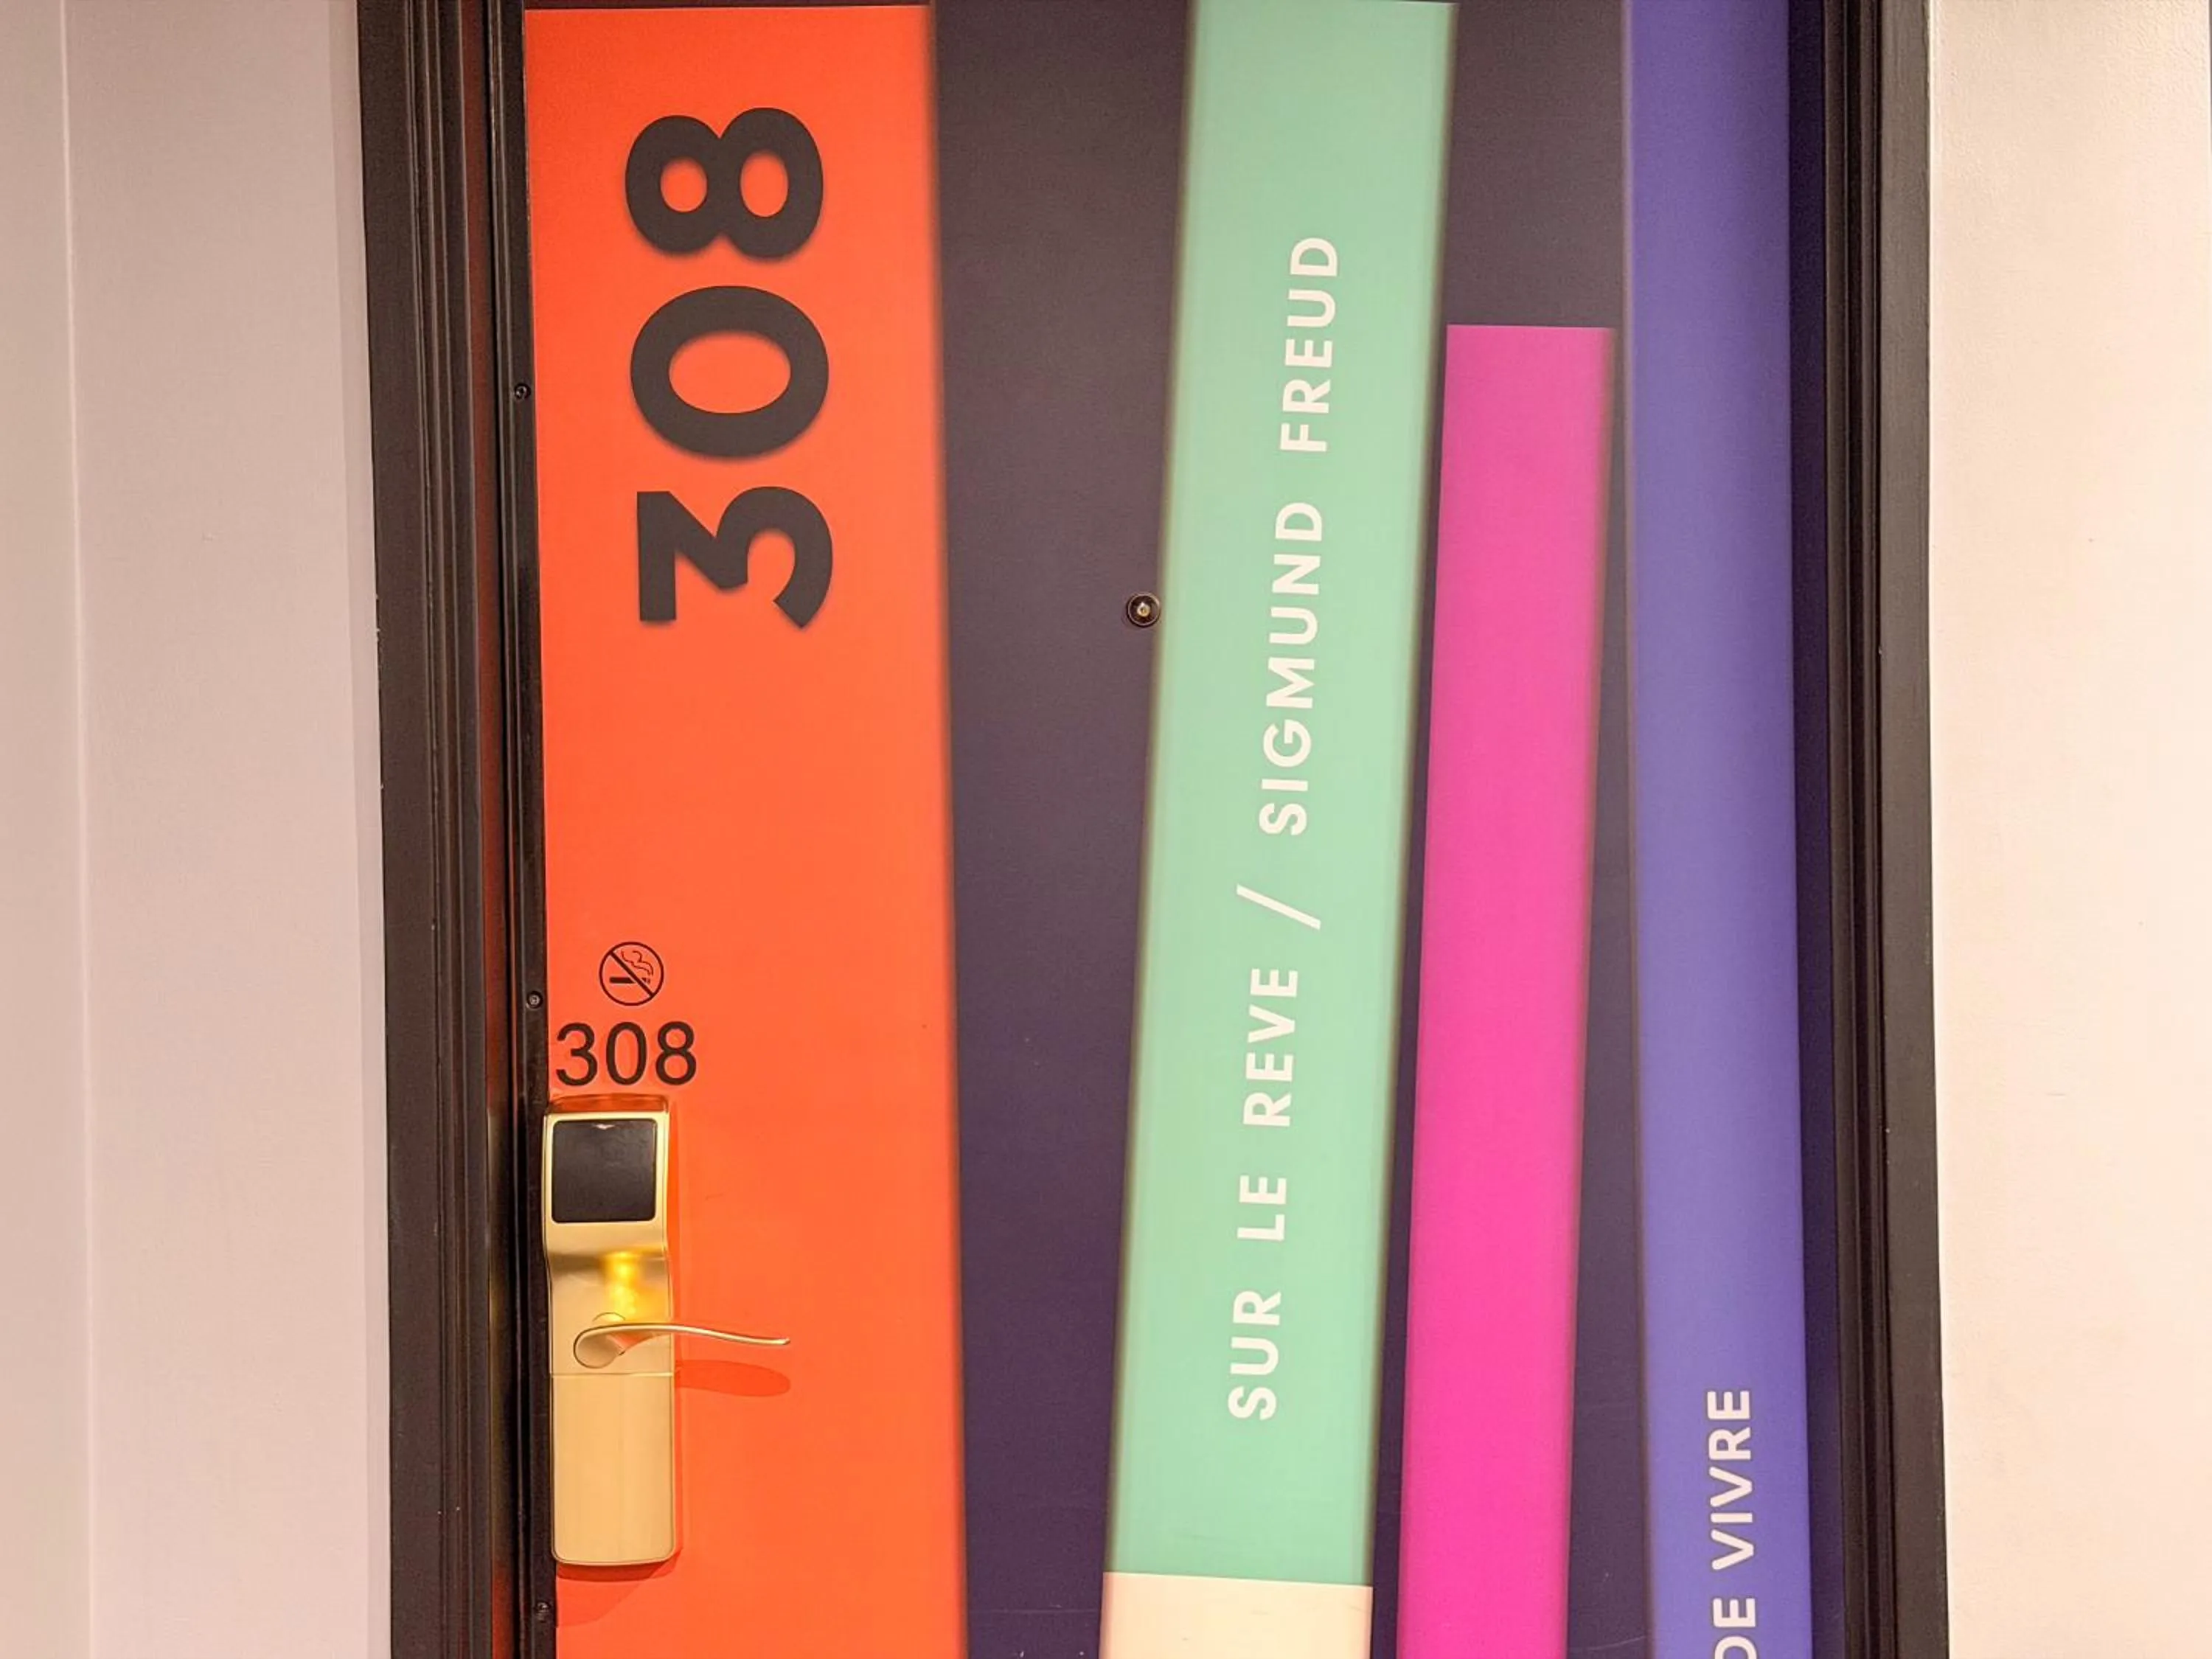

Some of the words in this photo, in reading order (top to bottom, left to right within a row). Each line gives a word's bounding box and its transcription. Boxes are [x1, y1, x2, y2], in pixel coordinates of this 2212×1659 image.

[624, 106, 834, 630] 308
[1279, 237, 1338, 453] FREUD
[1259, 502, 1323, 836] SIGMUND
[1236, 884, 1321, 931] /
[556, 1021, 698, 1087] 308
[1242, 968, 1298, 1127] REVE
[1237, 1175, 1287, 1242] LE
[1228, 1290, 1281, 1420] SUR
[1706, 1391, 1754, 1571] VIVRE
